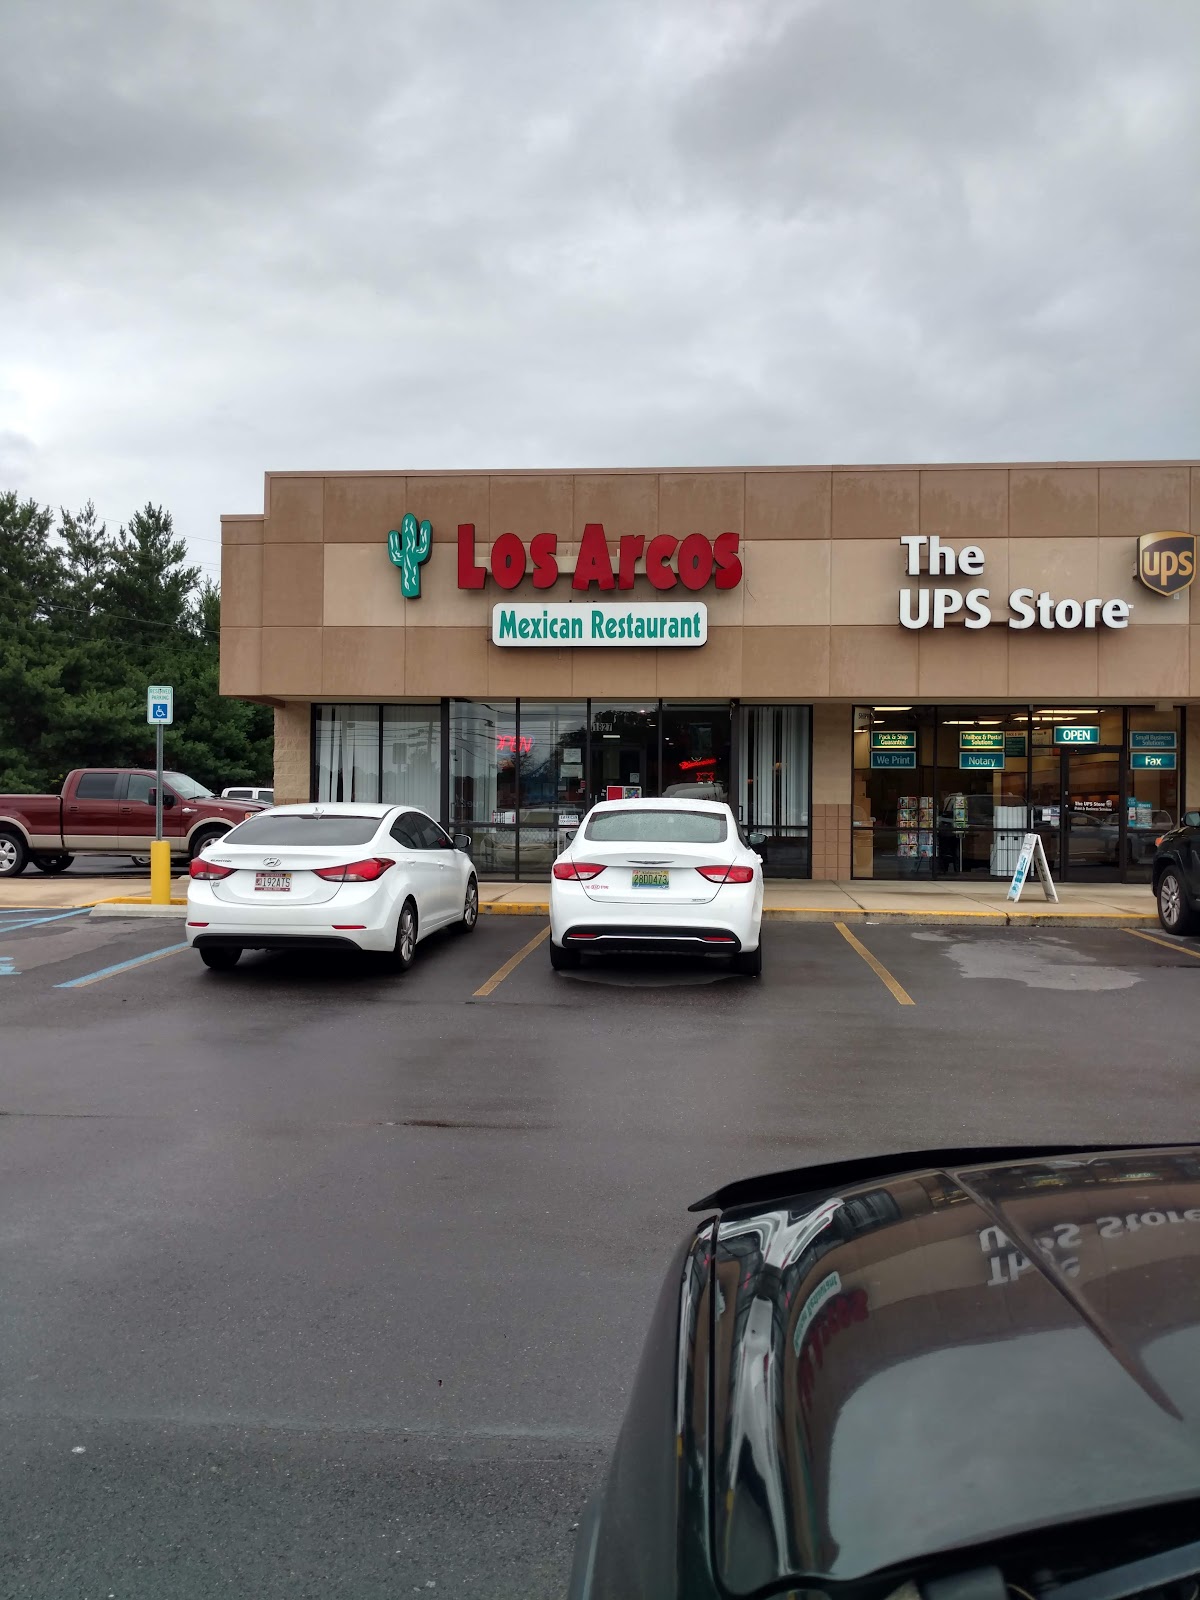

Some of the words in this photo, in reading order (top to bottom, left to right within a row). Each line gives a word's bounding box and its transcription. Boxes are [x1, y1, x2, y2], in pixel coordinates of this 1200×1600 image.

[457, 523, 559, 590] Los
[571, 523, 743, 590] Arcos
[900, 535, 985, 576] The
[1143, 550, 1193, 586] ups
[899, 588, 992, 629] UPS
[1008, 588, 1130, 629] Store
[498, 610, 583, 639] Mexican
[591, 610, 701, 639] Restaurant
[1063, 729, 1091, 741] OPEN
[876, 755, 890, 765] We
[891, 755, 910, 765] Print
[968, 756, 996, 767] Notary
[1145, 755, 1162, 766] Fax
